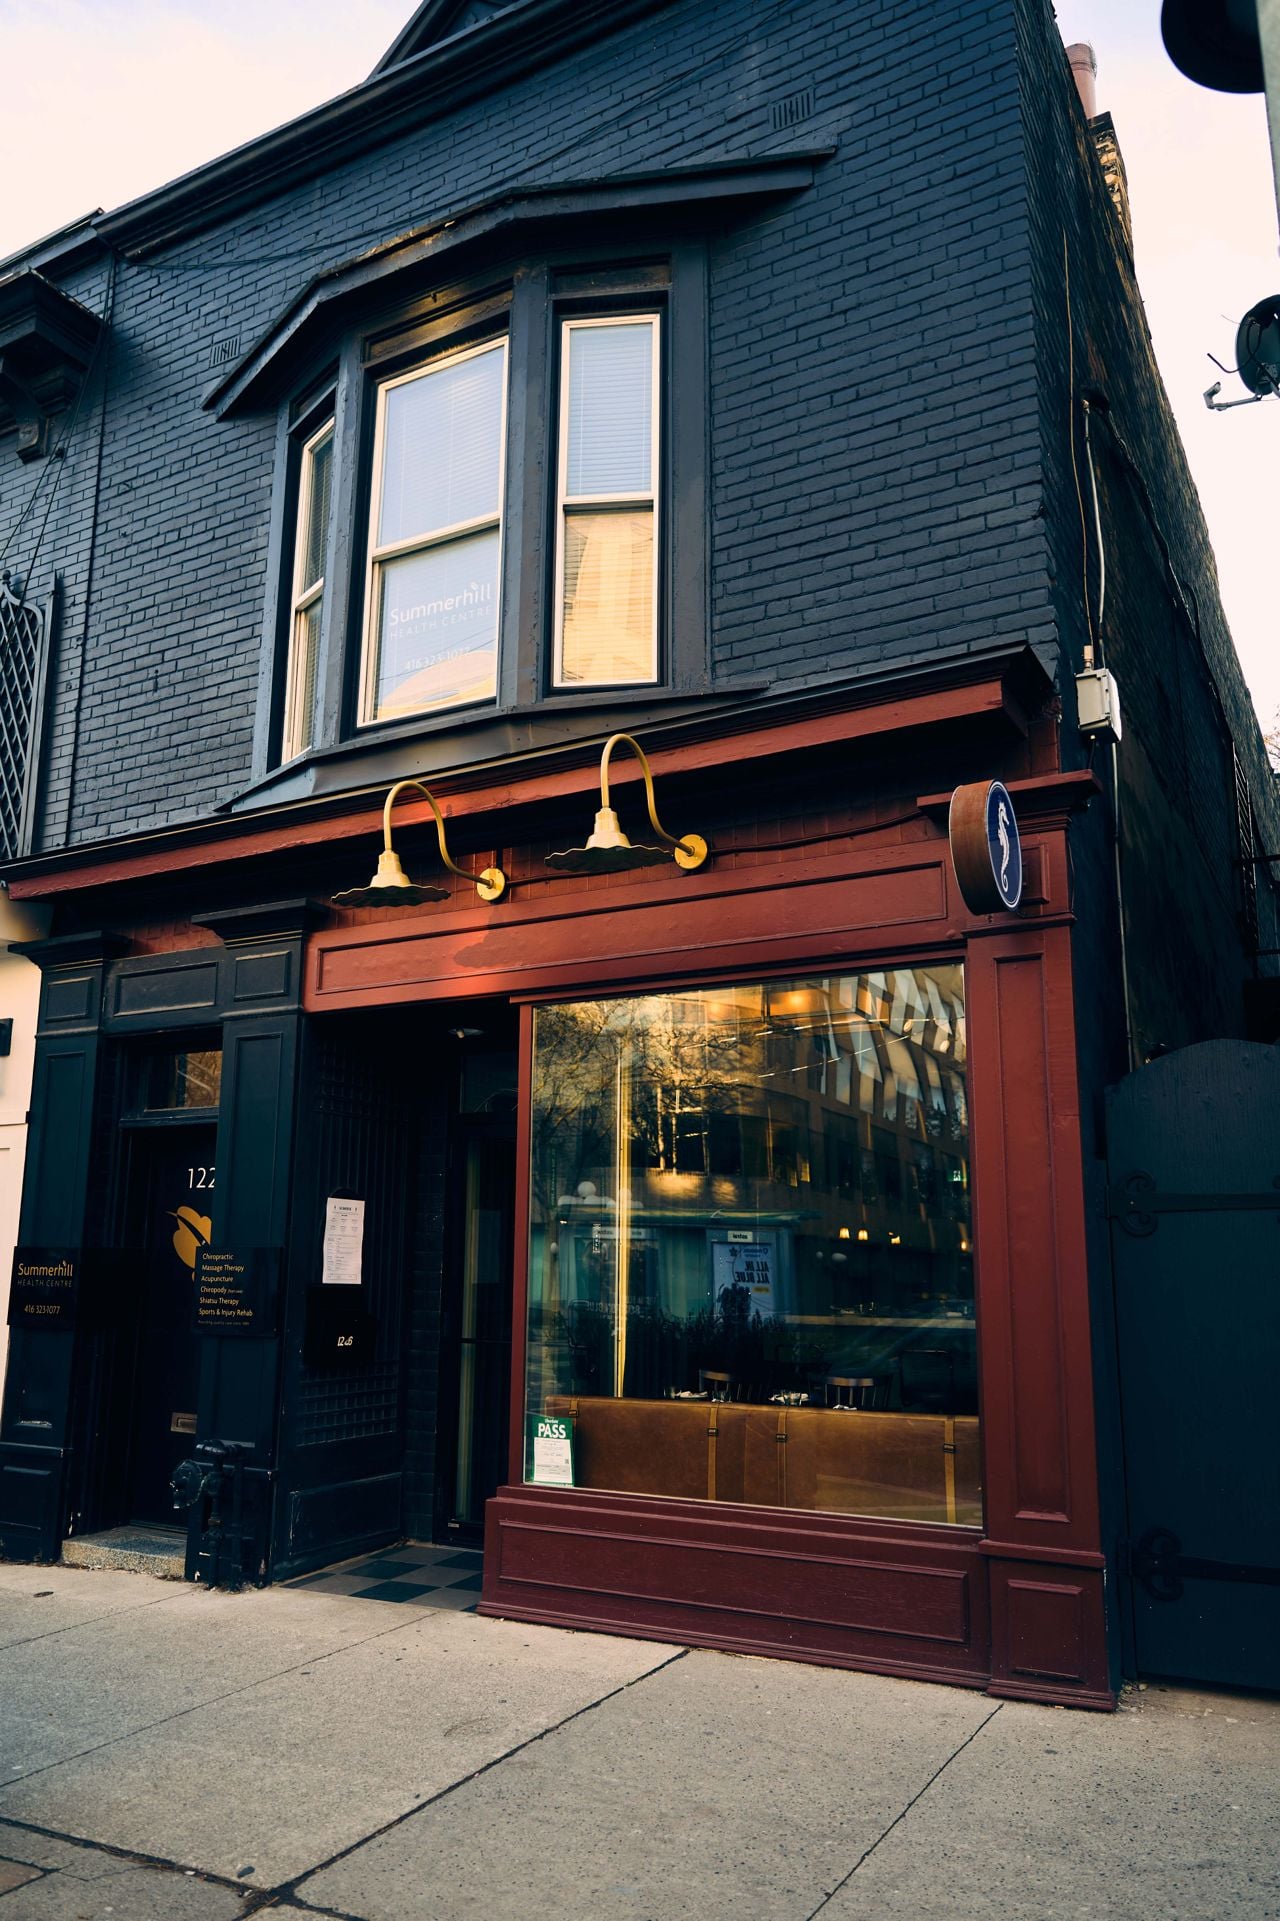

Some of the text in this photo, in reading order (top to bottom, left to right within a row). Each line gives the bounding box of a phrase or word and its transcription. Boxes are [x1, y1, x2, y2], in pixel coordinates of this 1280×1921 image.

[389, 581, 492, 627] Summerhill
[389, 605, 492, 641] HEALTH CENTRE
[202, 1253, 234, 1261] Chiropractic
[18, 1260, 73, 1277] Summerhill
[17, 1279, 73, 1288] HEALTH CENTRE
[200, 1286, 227, 1294] Chiropody
[219, 1297, 240, 1306] Therapy
[199, 1308, 216, 1316] Sports
[221, 1309, 236, 1317] Injury
[237, 1309, 253, 1317] Rehab
[538, 1423, 567, 1439] PASS
